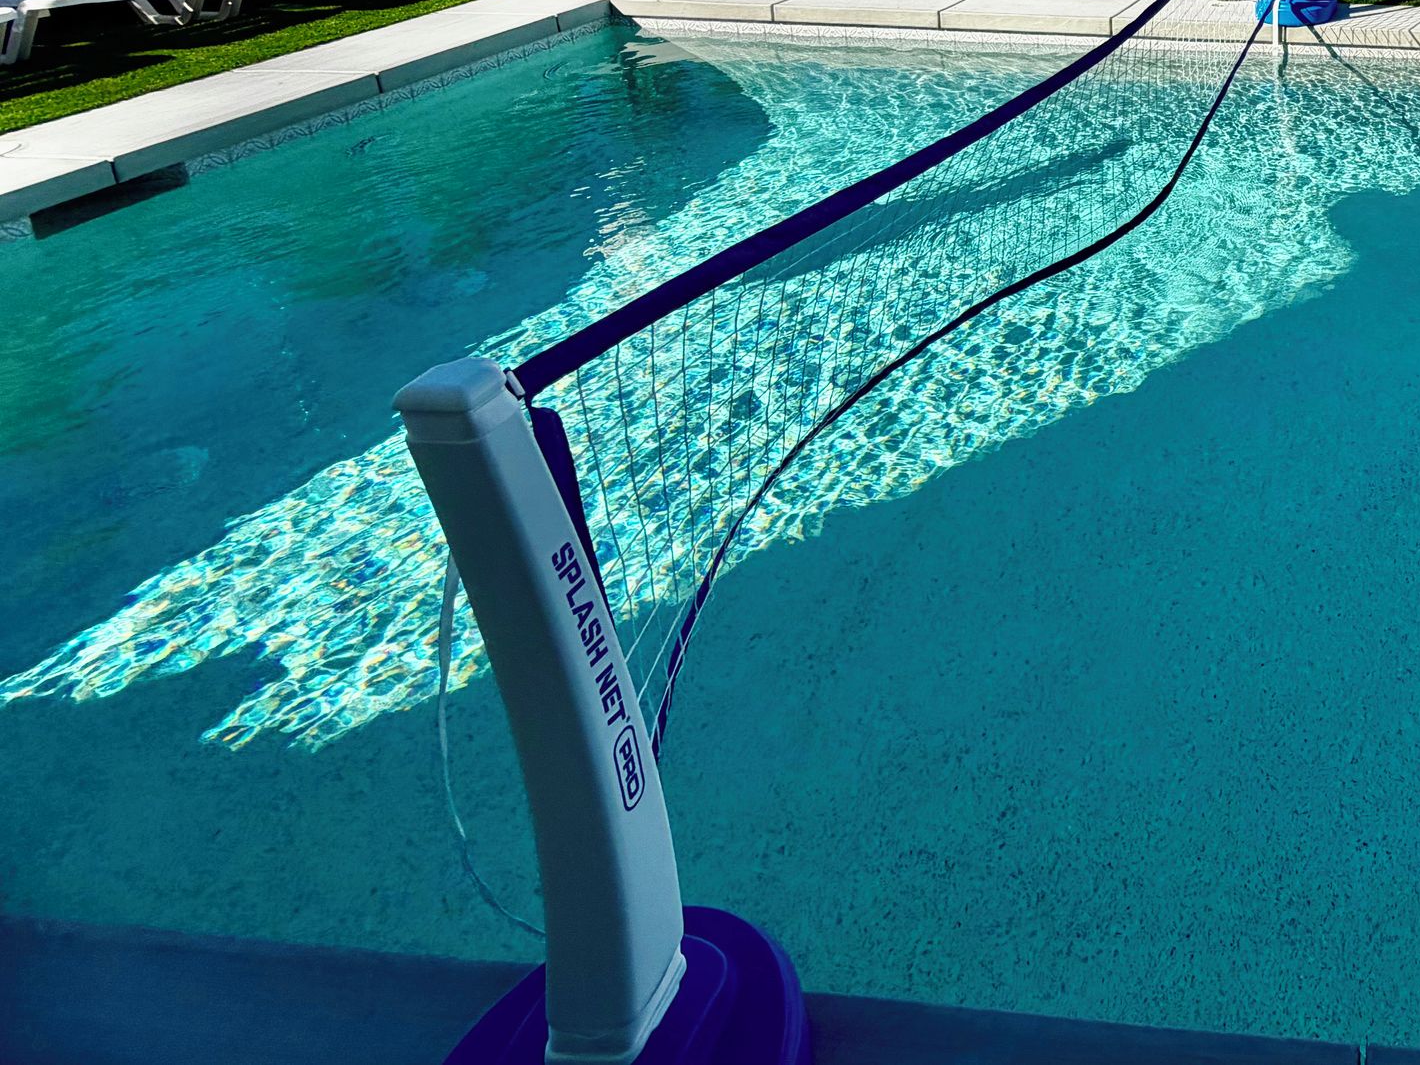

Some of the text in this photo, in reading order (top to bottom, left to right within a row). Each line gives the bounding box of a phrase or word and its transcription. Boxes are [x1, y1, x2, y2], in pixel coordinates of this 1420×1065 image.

[551, 541, 640, 800] SPLASH NET PRO
